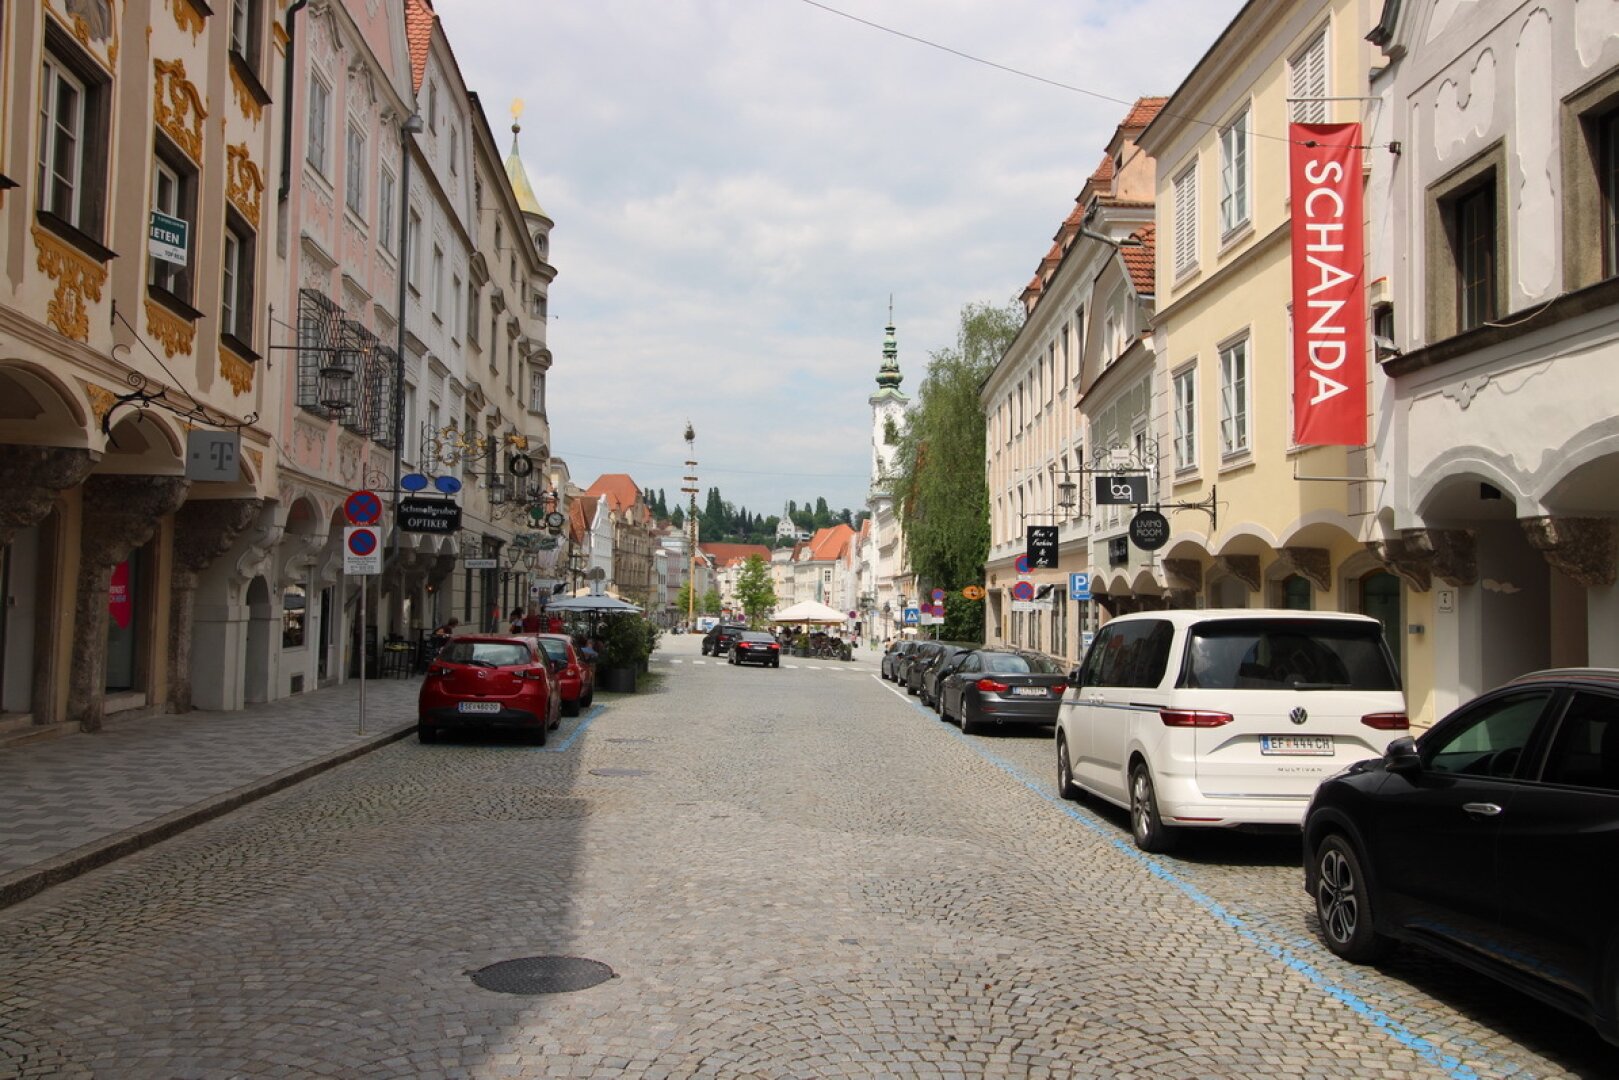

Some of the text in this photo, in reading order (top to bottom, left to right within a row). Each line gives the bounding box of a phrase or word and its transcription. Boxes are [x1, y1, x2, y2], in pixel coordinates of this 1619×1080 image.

[1304, 159, 1355, 406] SCHANDA
[407, 517, 448, 529] OPTIKER
[1135, 520, 1162, 528] LIVING
[1135, 528, 1163, 537] ROOM
[1075, 576, 1086, 591] P
[1270, 737, 1330, 749] EF 444 CH
